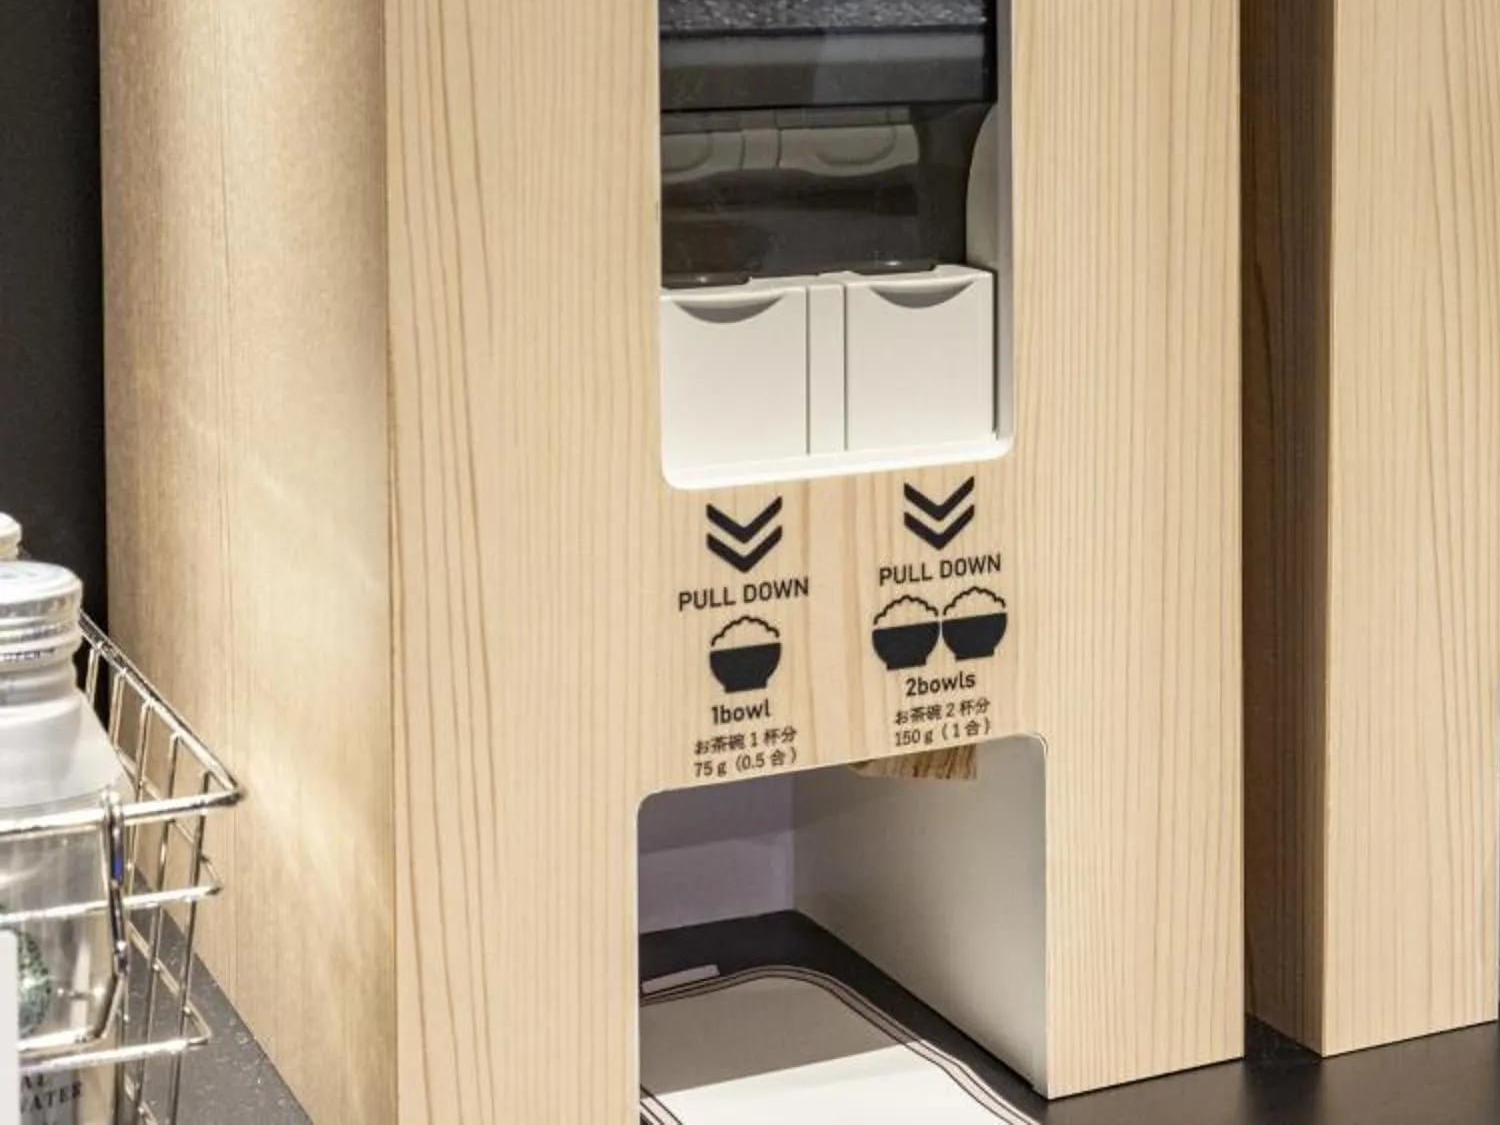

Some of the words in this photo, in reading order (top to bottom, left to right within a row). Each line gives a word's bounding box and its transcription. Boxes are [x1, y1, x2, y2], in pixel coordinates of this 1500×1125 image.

[879, 563, 933, 586] PULL
[939, 553, 1002, 579] DOWN
[678, 588, 735, 611] PULL
[743, 577, 810, 605] DOWN
[905, 671, 976, 697] 2bowls
[712, 699, 770, 725] 1bowl
